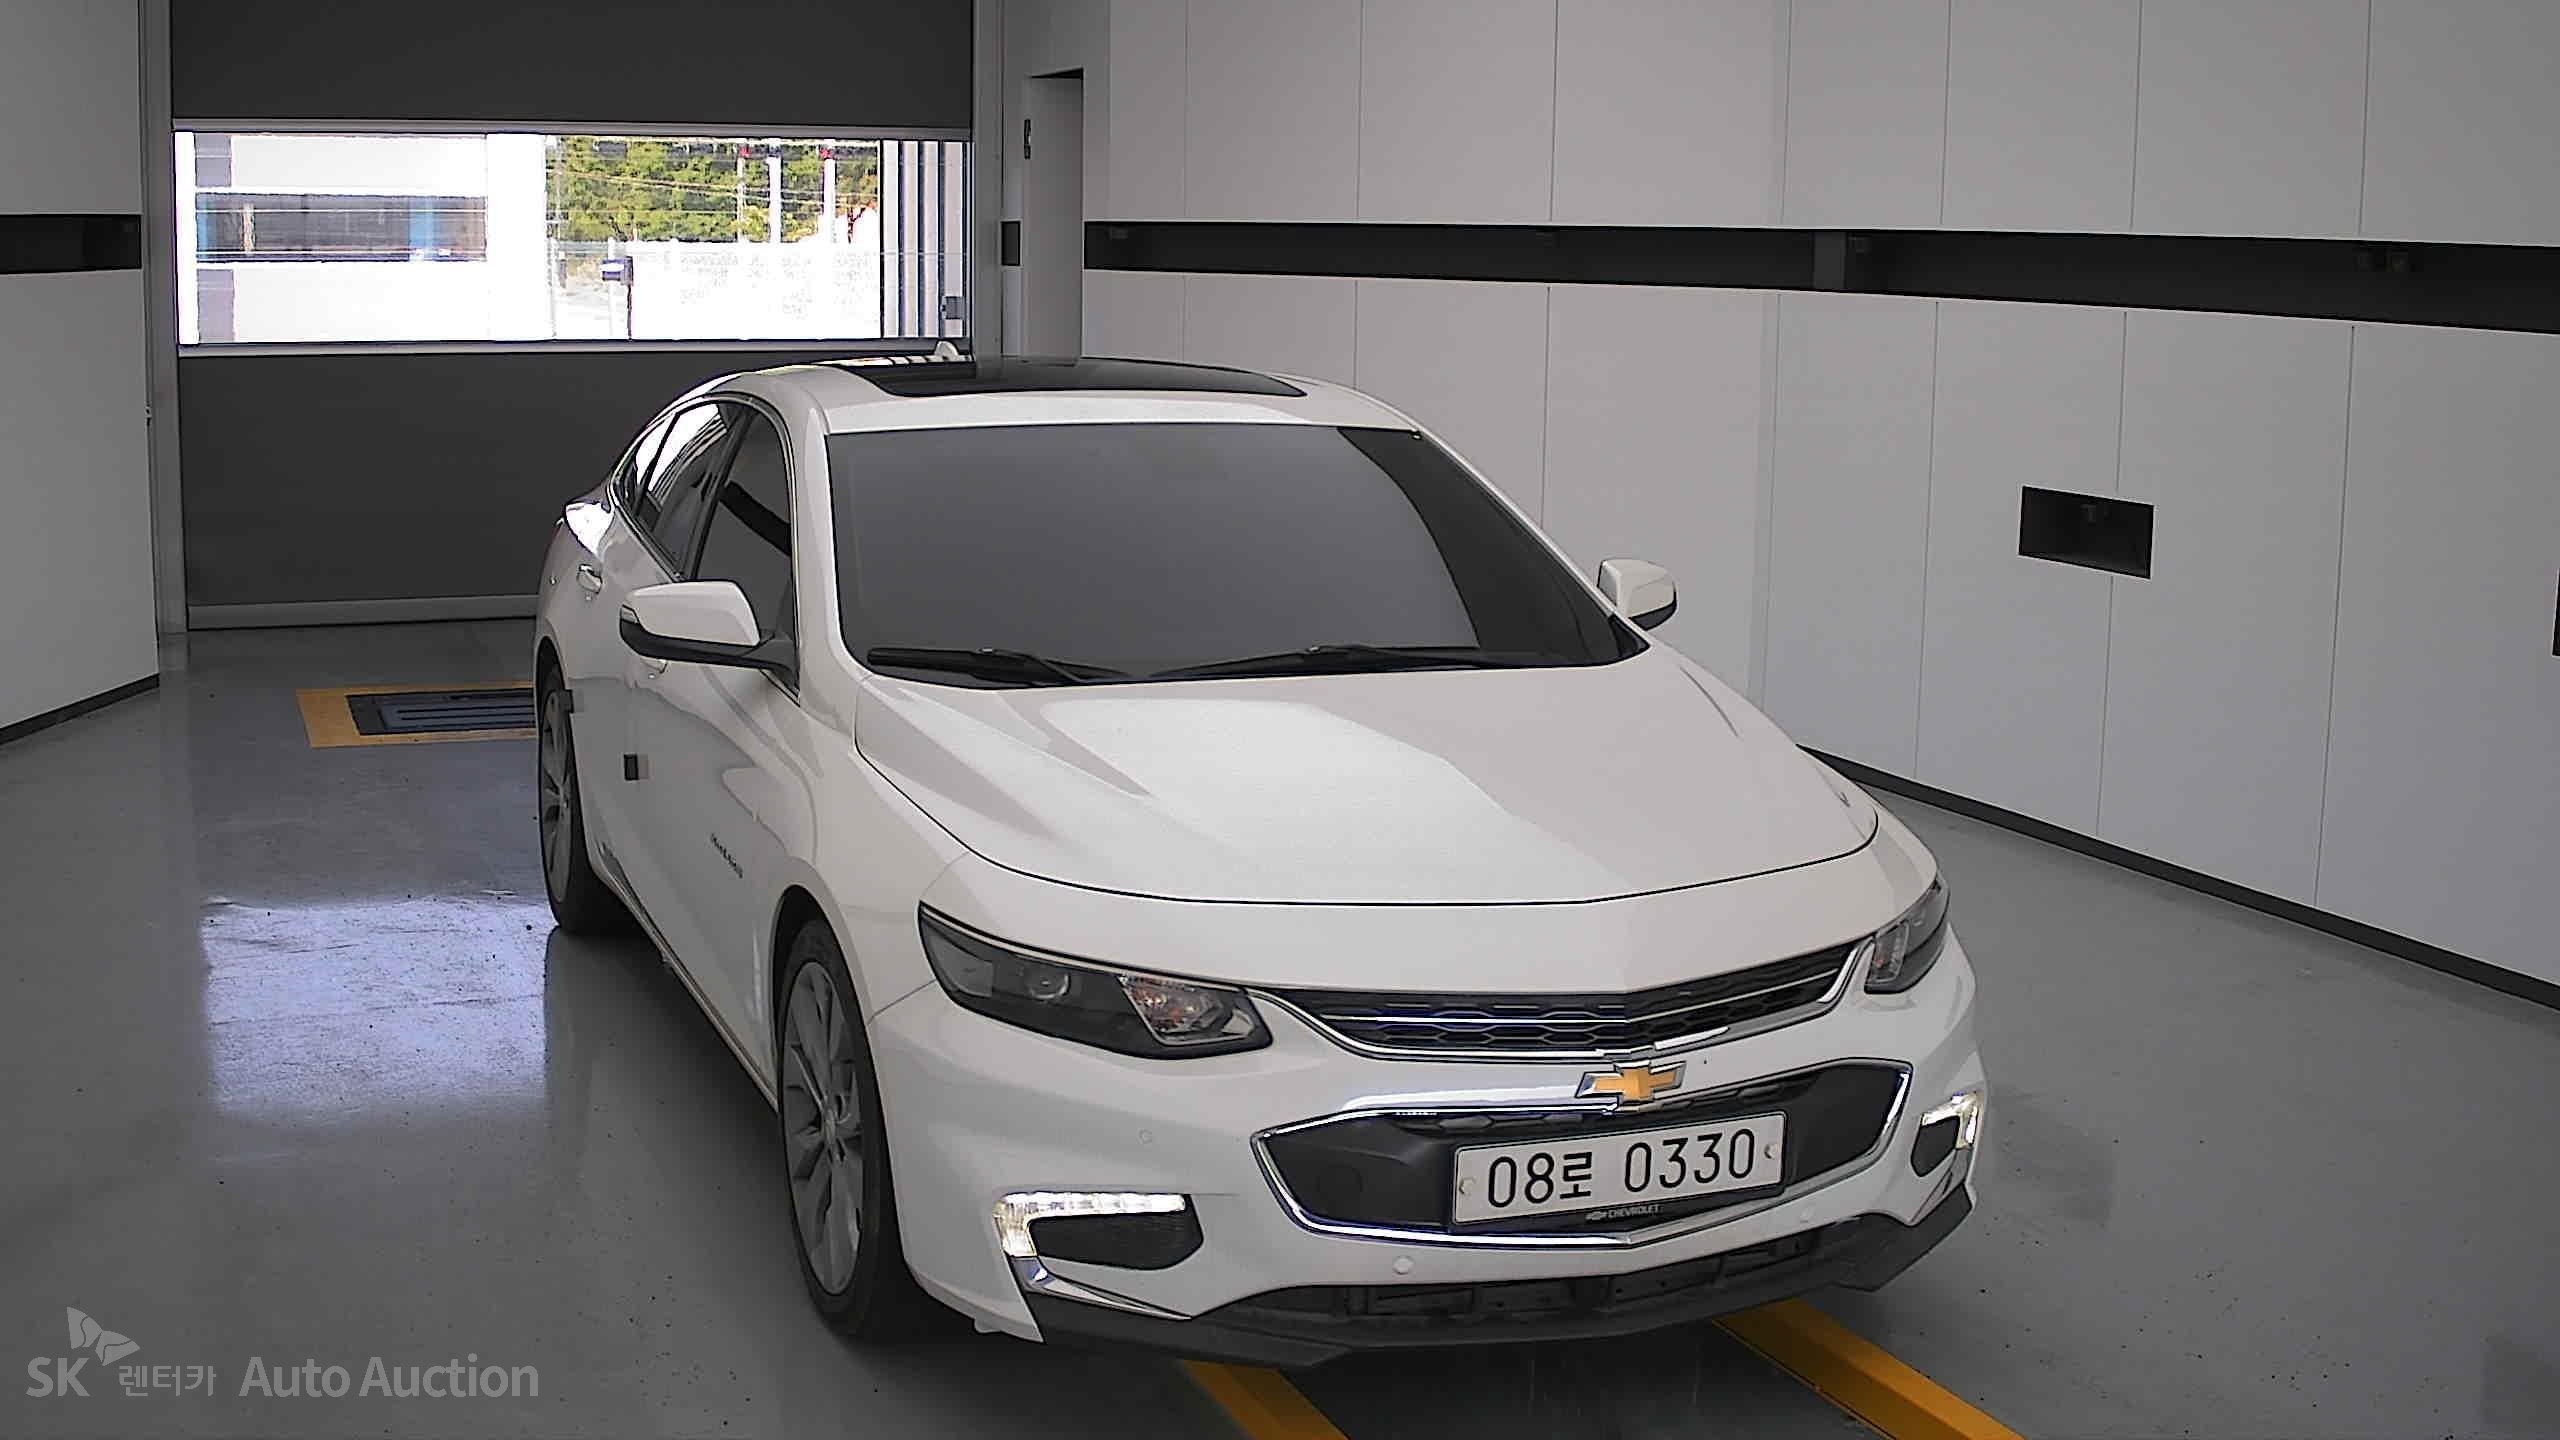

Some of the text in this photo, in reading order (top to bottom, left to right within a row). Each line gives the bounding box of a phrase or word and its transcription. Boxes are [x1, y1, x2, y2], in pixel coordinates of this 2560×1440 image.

[1487, 1128, 1755, 1208] 08로 0330
[1607, 1204, 1660, 1220] CHEVROLET
